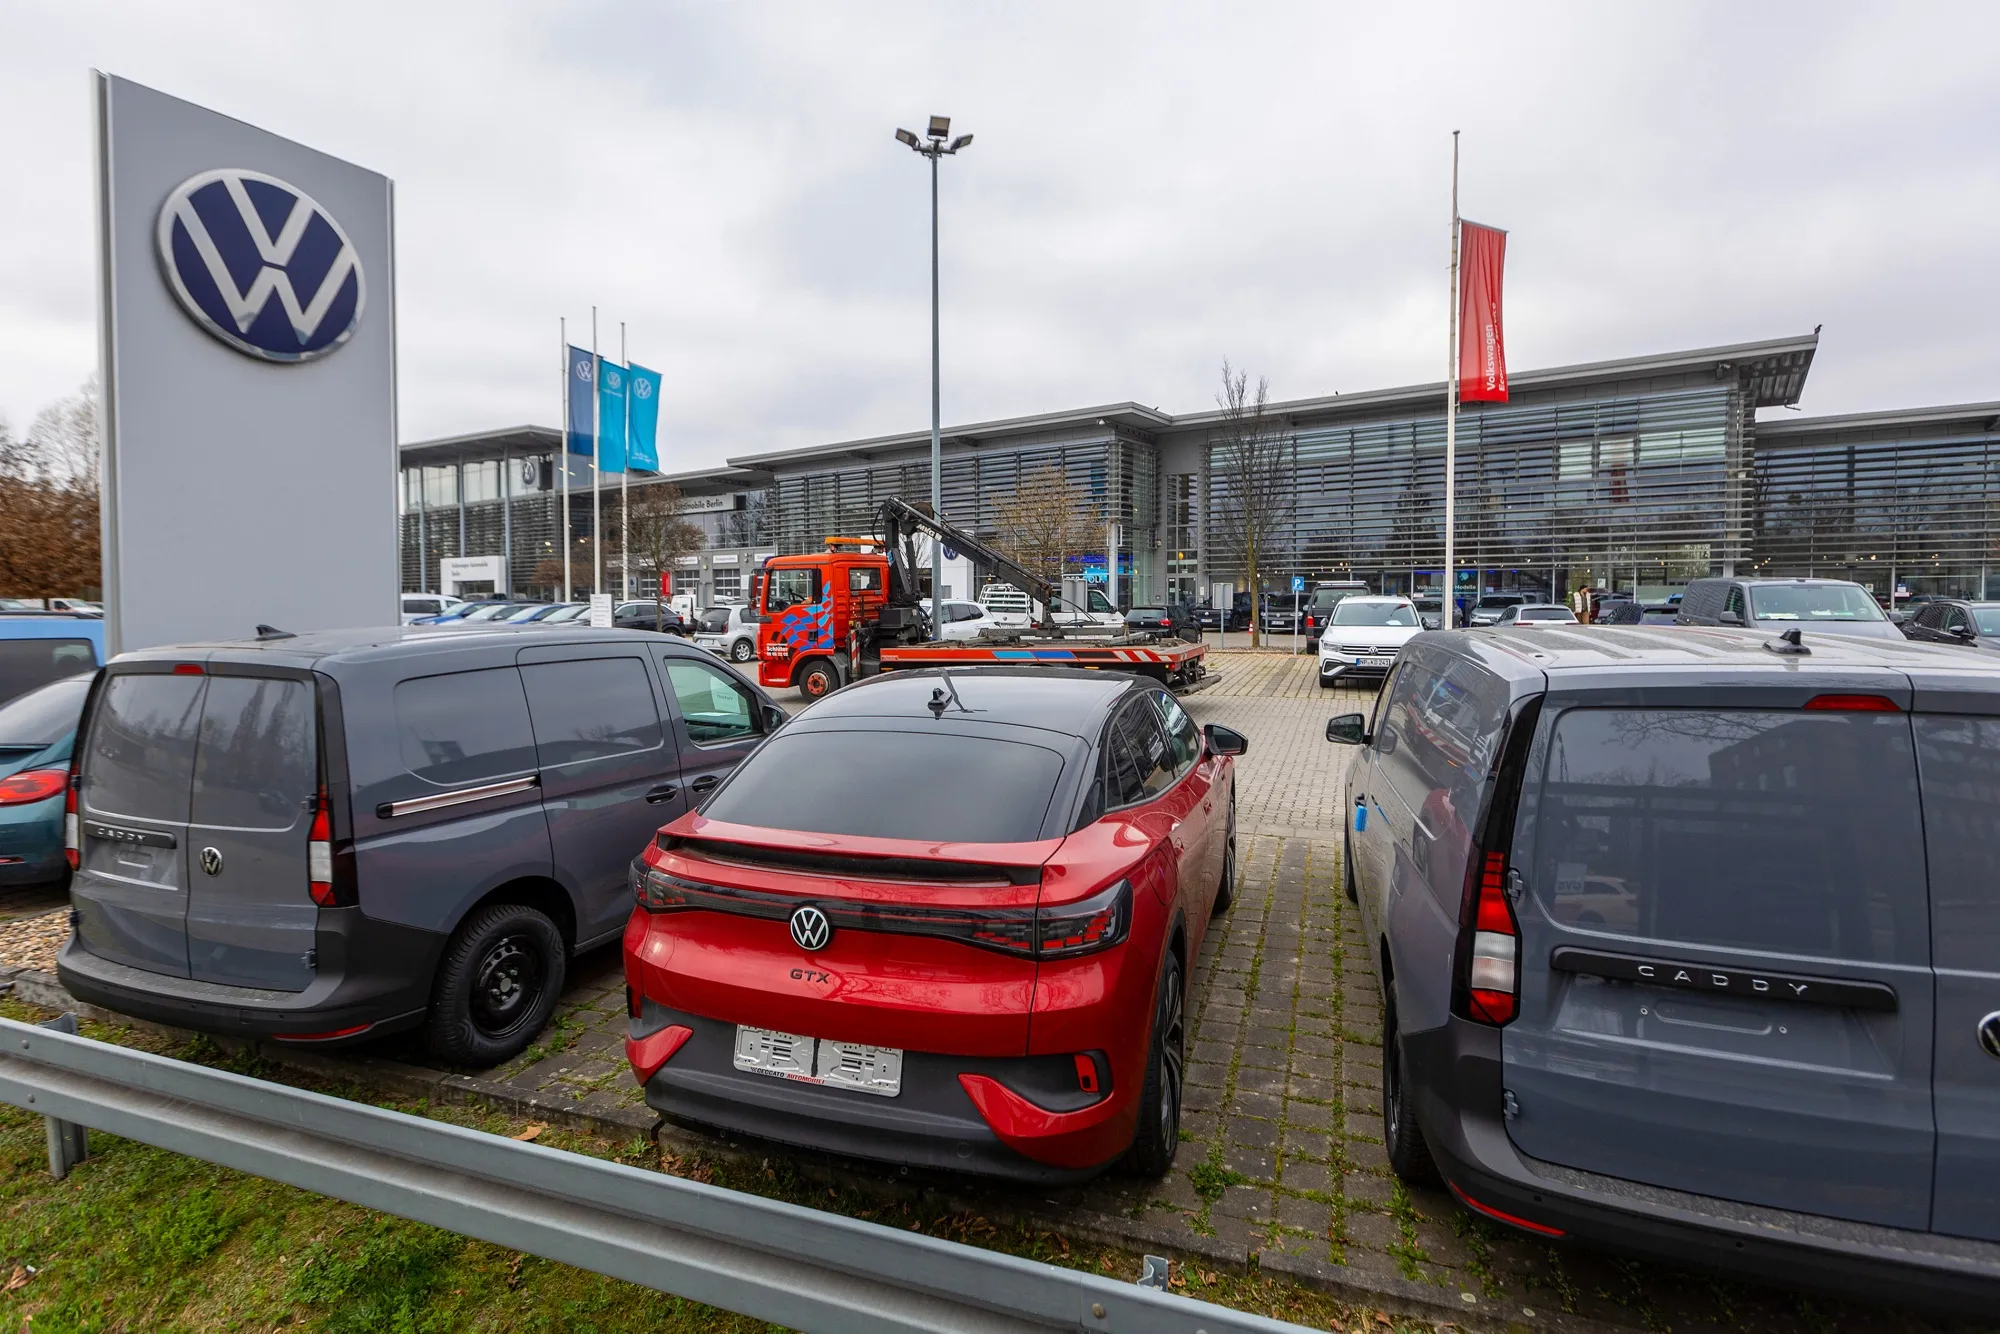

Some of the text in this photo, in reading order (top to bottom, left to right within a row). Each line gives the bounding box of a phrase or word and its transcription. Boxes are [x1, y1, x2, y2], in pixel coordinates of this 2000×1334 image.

[158, 168, 366, 363] VW
[1485, 324, 1496, 391] Volkswagen
[706, 498, 723, 508] Berlin
[1294, 579, 1301, 588] P
[97, 827, 146, 841] CADDY
[790, 907, 829, 950] VW
[790, 967, 830, 984] GTX
[1637, 965, 1808, 995] CADDY
[756, 1067, 825, 1085] CECCATO AUTOMOBILI
